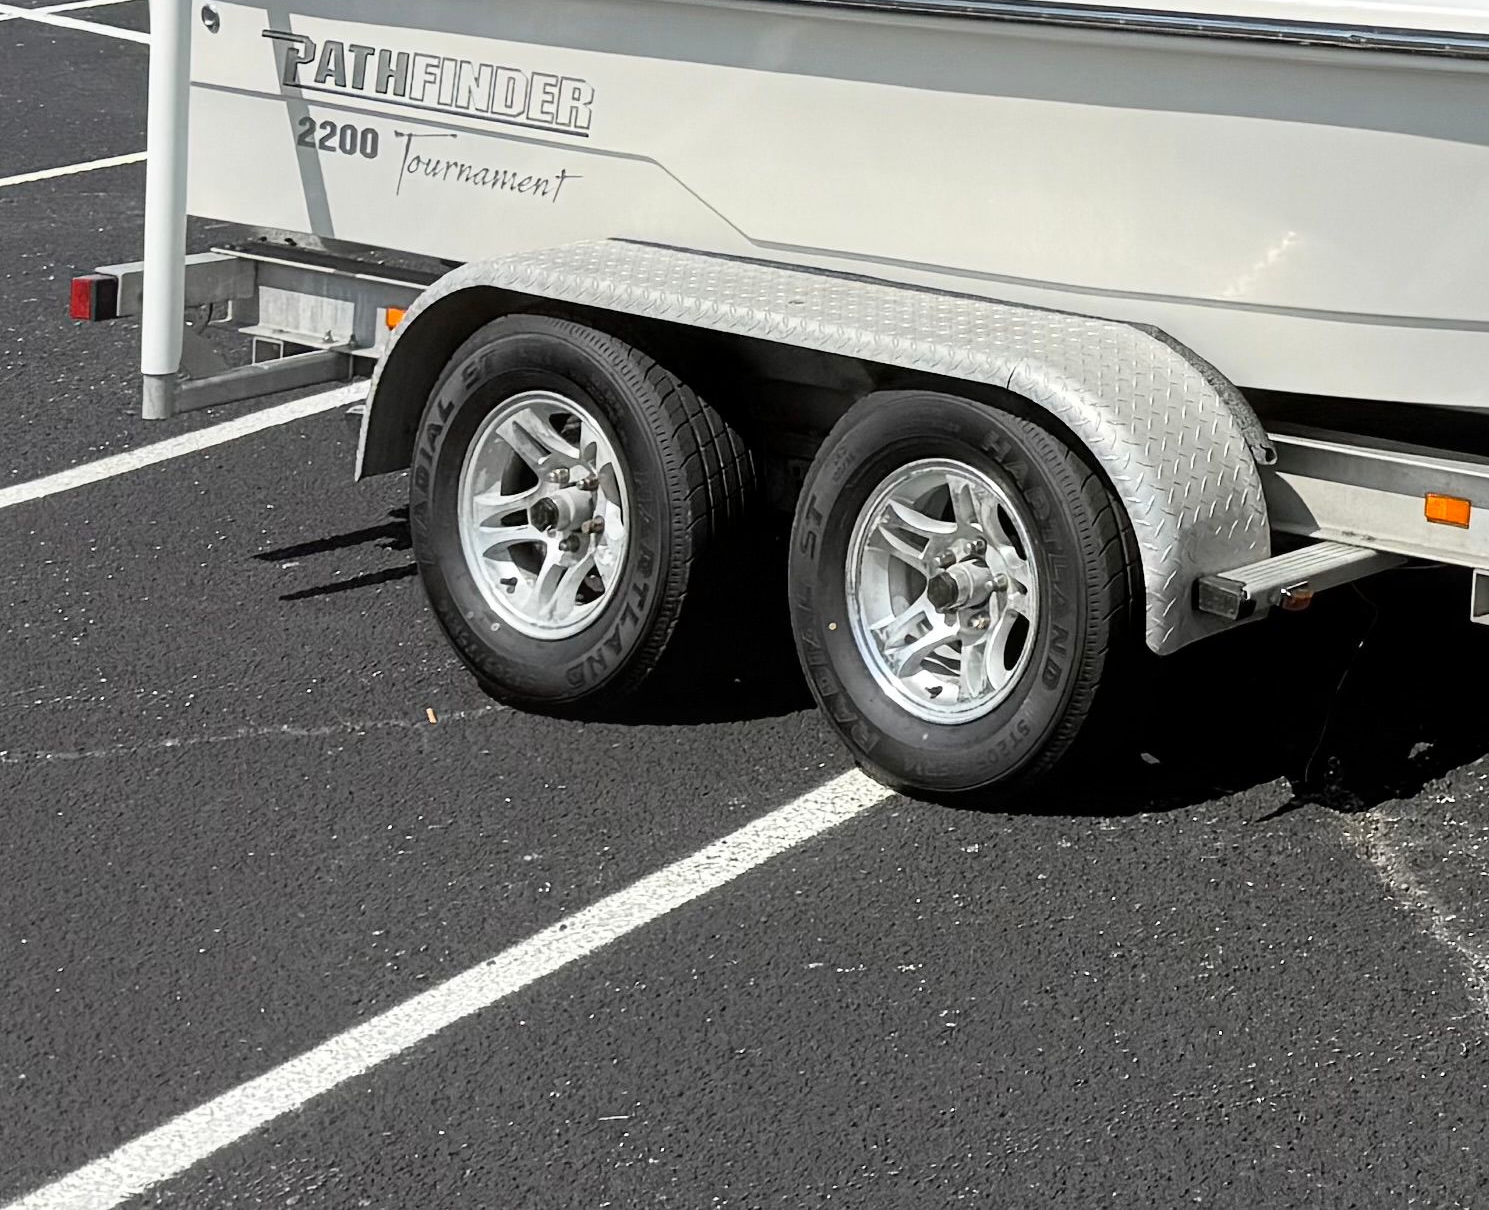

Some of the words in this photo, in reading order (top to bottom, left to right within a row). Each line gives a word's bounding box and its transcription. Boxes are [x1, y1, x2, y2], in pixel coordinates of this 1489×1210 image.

[262, 29, 595, 131] PATHFINDER
[297, 116, 379, 159] 2200
[394, 129, 583, 203] Tournament
